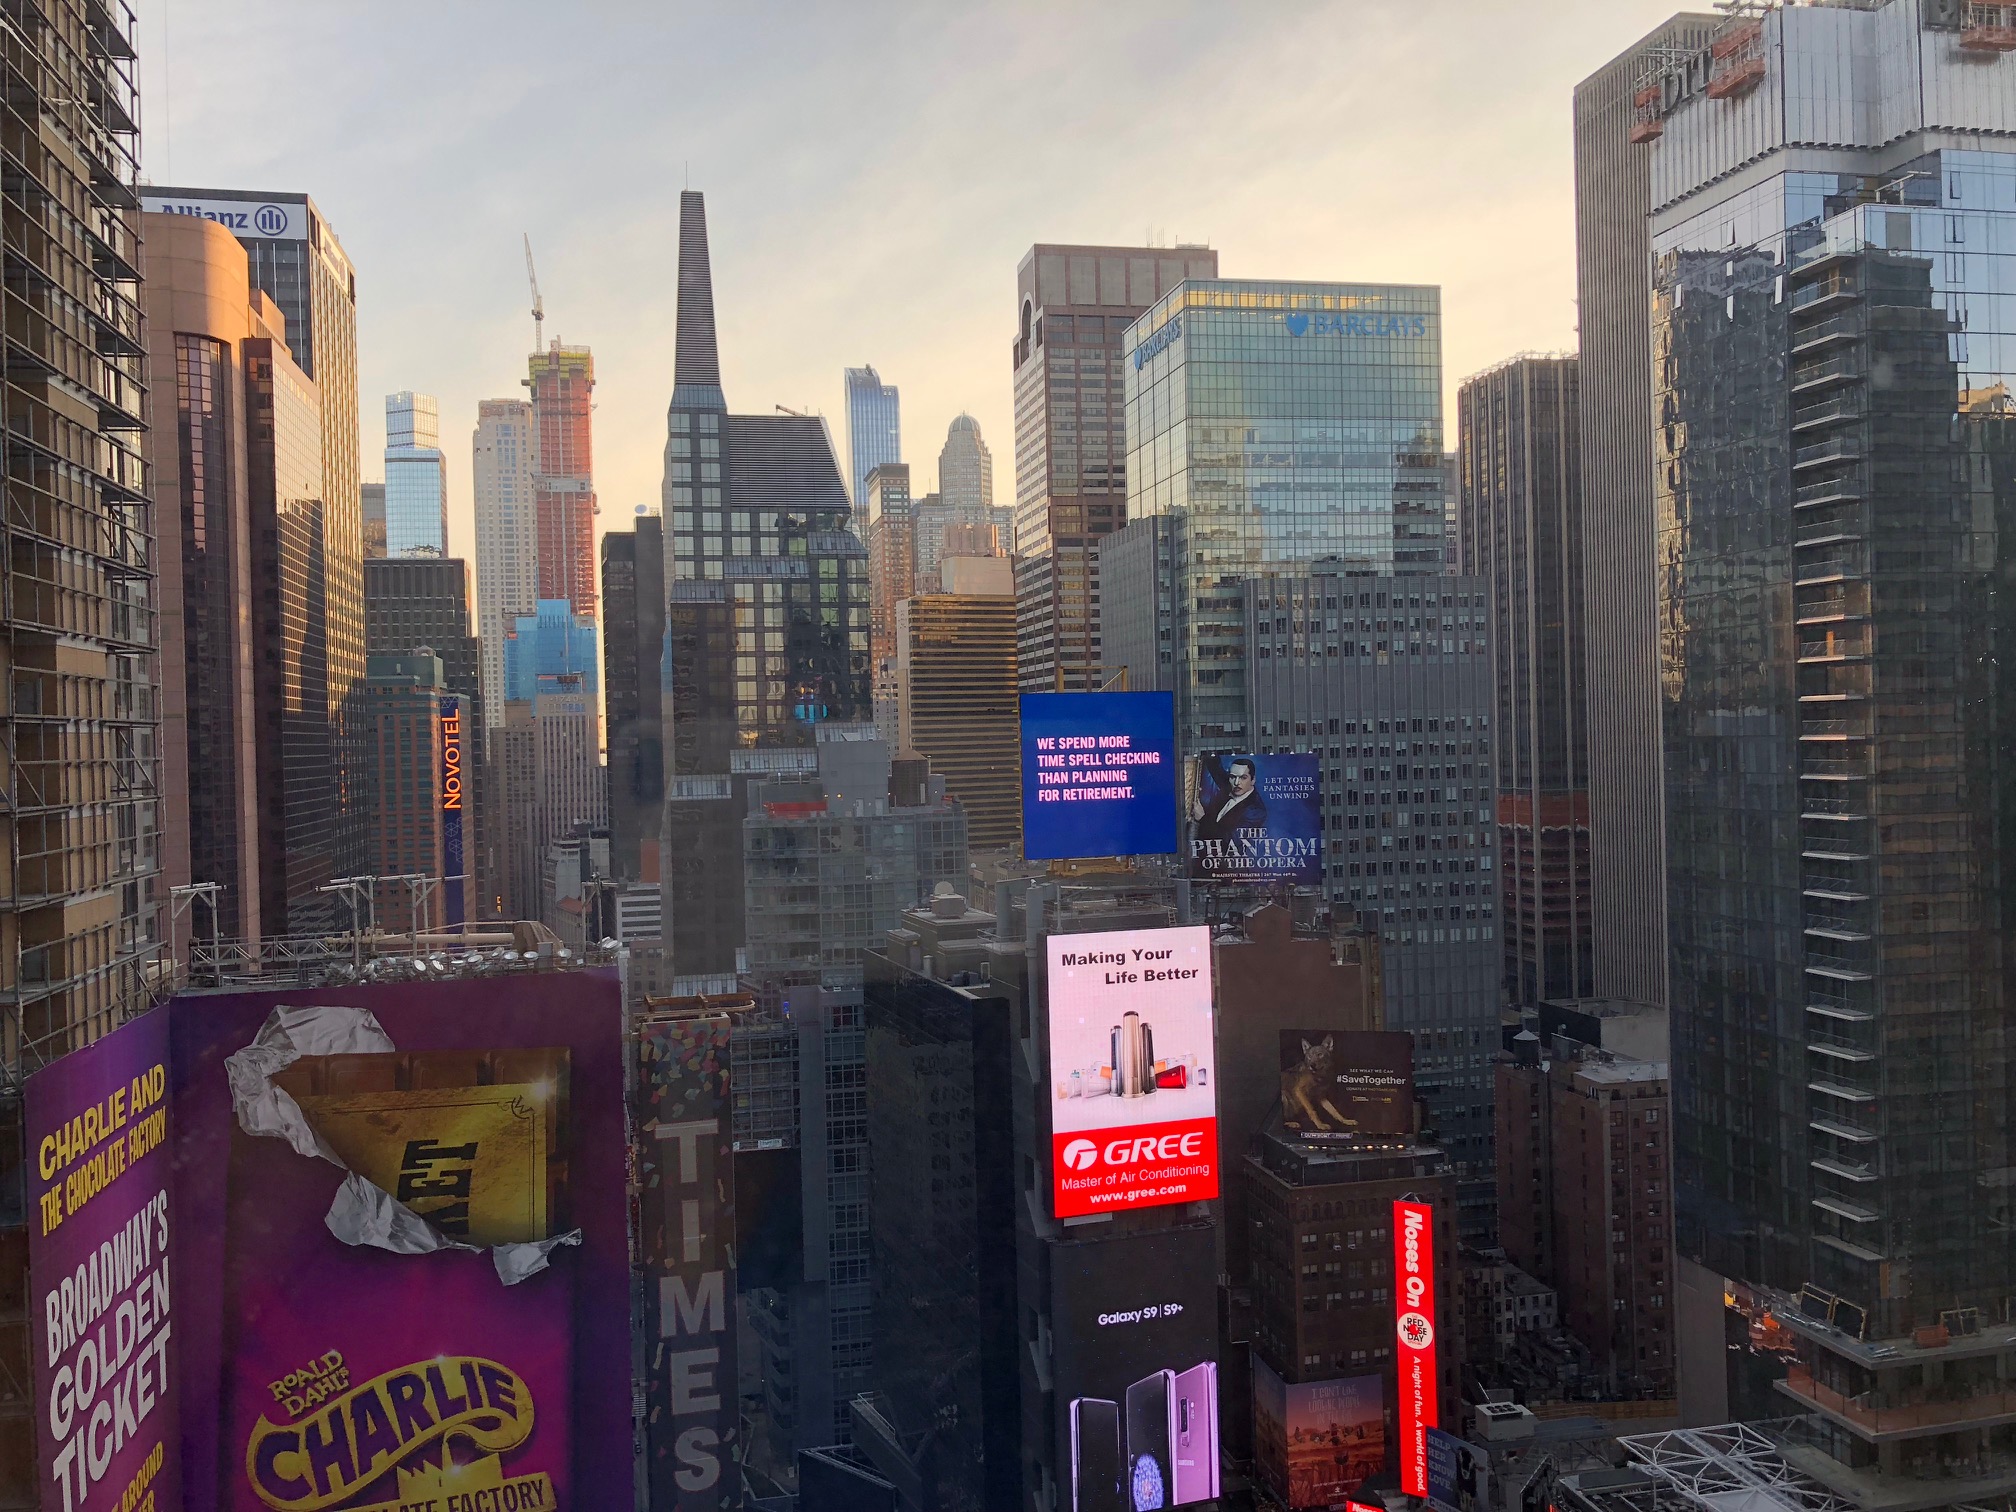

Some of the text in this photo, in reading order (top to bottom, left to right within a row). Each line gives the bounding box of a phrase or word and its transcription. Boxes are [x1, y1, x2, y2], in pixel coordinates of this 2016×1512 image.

[1314, 313, 1426, 337] BARCLAYS
[1142, 316, 1182, 363] BARCLAYS
[1037, 736, 1130, 749] WE SPEND MORE
[442, 709, 462, 809] NOVOTEL
[1037, 752, 1160, 767] TIME SPELL CHECKING
[1038, 770, 1127, 784] THAN PLANNING
[1039, 787, 1134, 801] FOR RETIREMENT.
[1237, 828, 1268, 838] THE
[1190, 838, 1317, 858] PHANTOM
[1202, 857, 1306, 869] OF THE OPERA
[1061, 949, 1173, 966] Making Your
[1105, 967, 1198, 984] Life Better
[1337, 1075, 1406, 1085] #SaveTogether
[39, 1064, 165, 1181] CHARLIE AND
[1103, 1132, 1203, 1165] GREE
[40, 1105, 166, 1237] THE CHOCOLATE FACTORY
[1061, 1163, 1210, 1190] Master of Air Conditioning
[1090, 1184, 1186, 1203] www.gree.com
[1404, 1209, 1425, 1307] Noses On
[46, 1189, 168, 1368] BROADWAY'S
[655, 1119, 727, 1491] TIMES
[1098, 1303, 1183, 1325] Galaxy S9 S9+
[1407, 1317, 1424, 1326] RED
[51, 1256, 170, 1441] GOLDEN
[1407, 1333, 1424, 1343] DAY
[267, 1350, 344, 1401] ROALD
[282, 1366, 349, 1417] DAHL'S
[53, 1320, 171, 1512] TICKET
[1412, 1356, 1426, 1492] A night of fun. A world of good.
[255, 1360, 518, 1501] CHARLIE
[1427, 1434, 1451, 1451] HELP
[1427, 1447, 1446, 1462] HER
[122, 1441, 164, 1512] AROUND
[1428, 1459, 1457, 1480] KNOW
[1428, 1472, 1453, 1491] LOVE.
[446, 1479, 546, 1512] FACTORY
